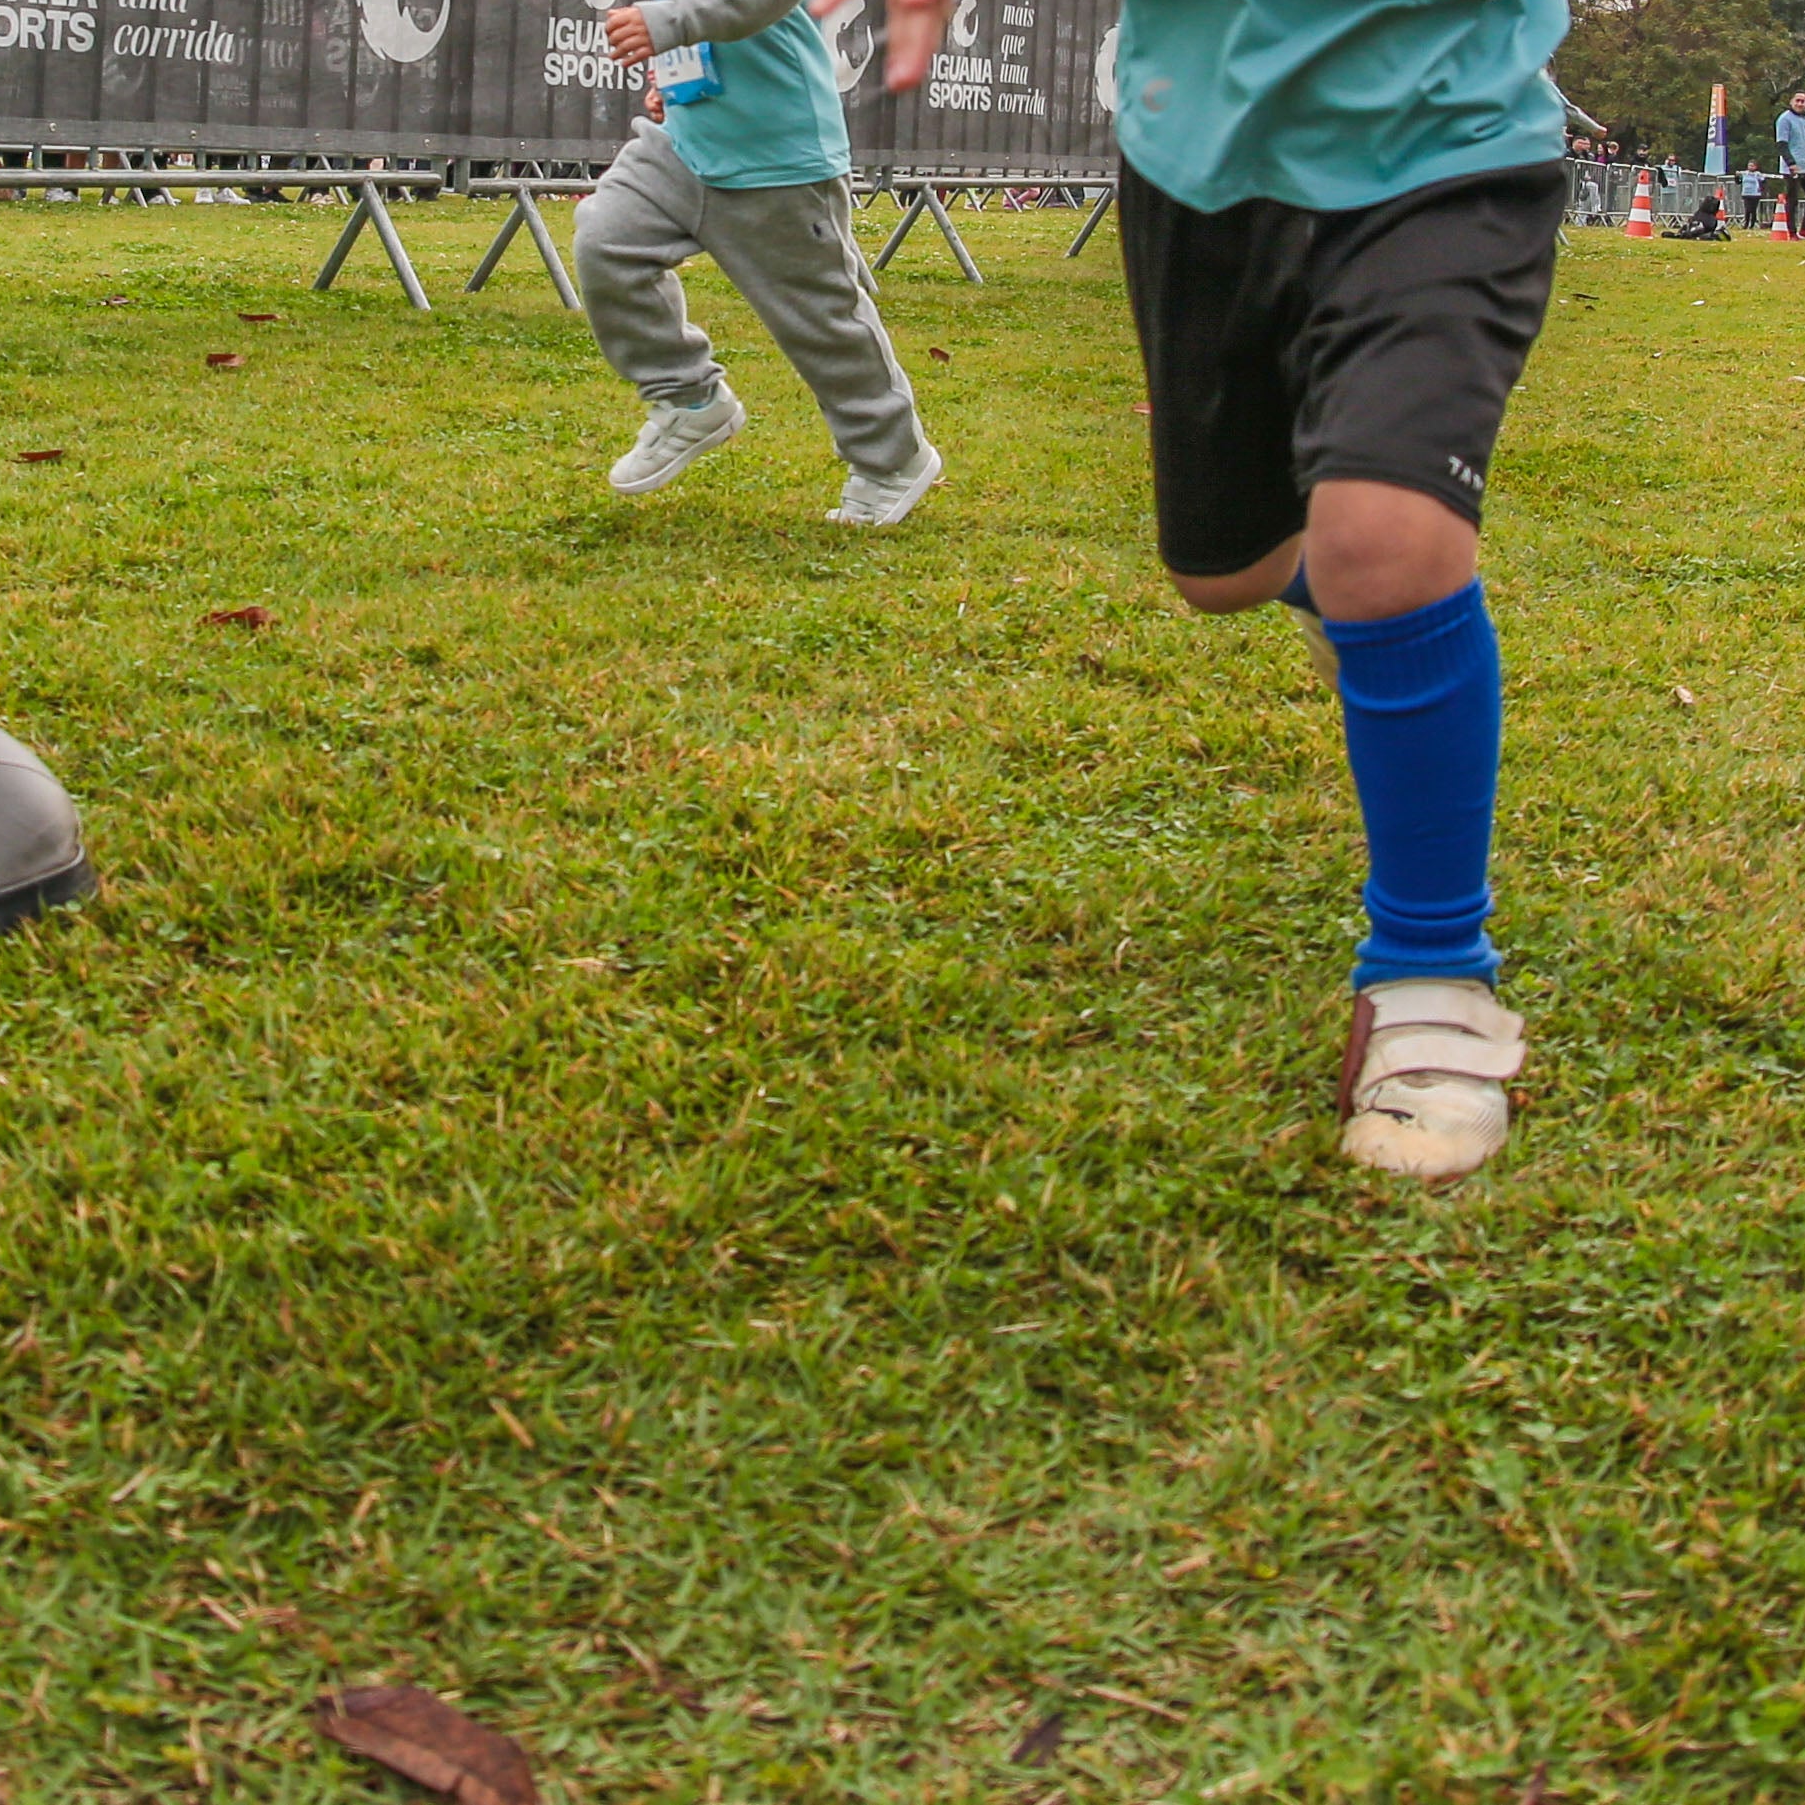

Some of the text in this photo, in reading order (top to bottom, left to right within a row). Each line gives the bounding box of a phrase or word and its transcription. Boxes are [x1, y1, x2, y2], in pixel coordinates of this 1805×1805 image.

[1003, 1, 1035, 28] mais
[113, 19, 235, 63] corrida
[1001, 34, 1026, 62] que
[543, 52, 645, 92] SPORTS
[932, 53, 993, 85] IGUANA
[999, 63, 1029, 85] uma
[928, 81, 992, 113] SPORTS
[997, 87, 1046, 116] corrida
